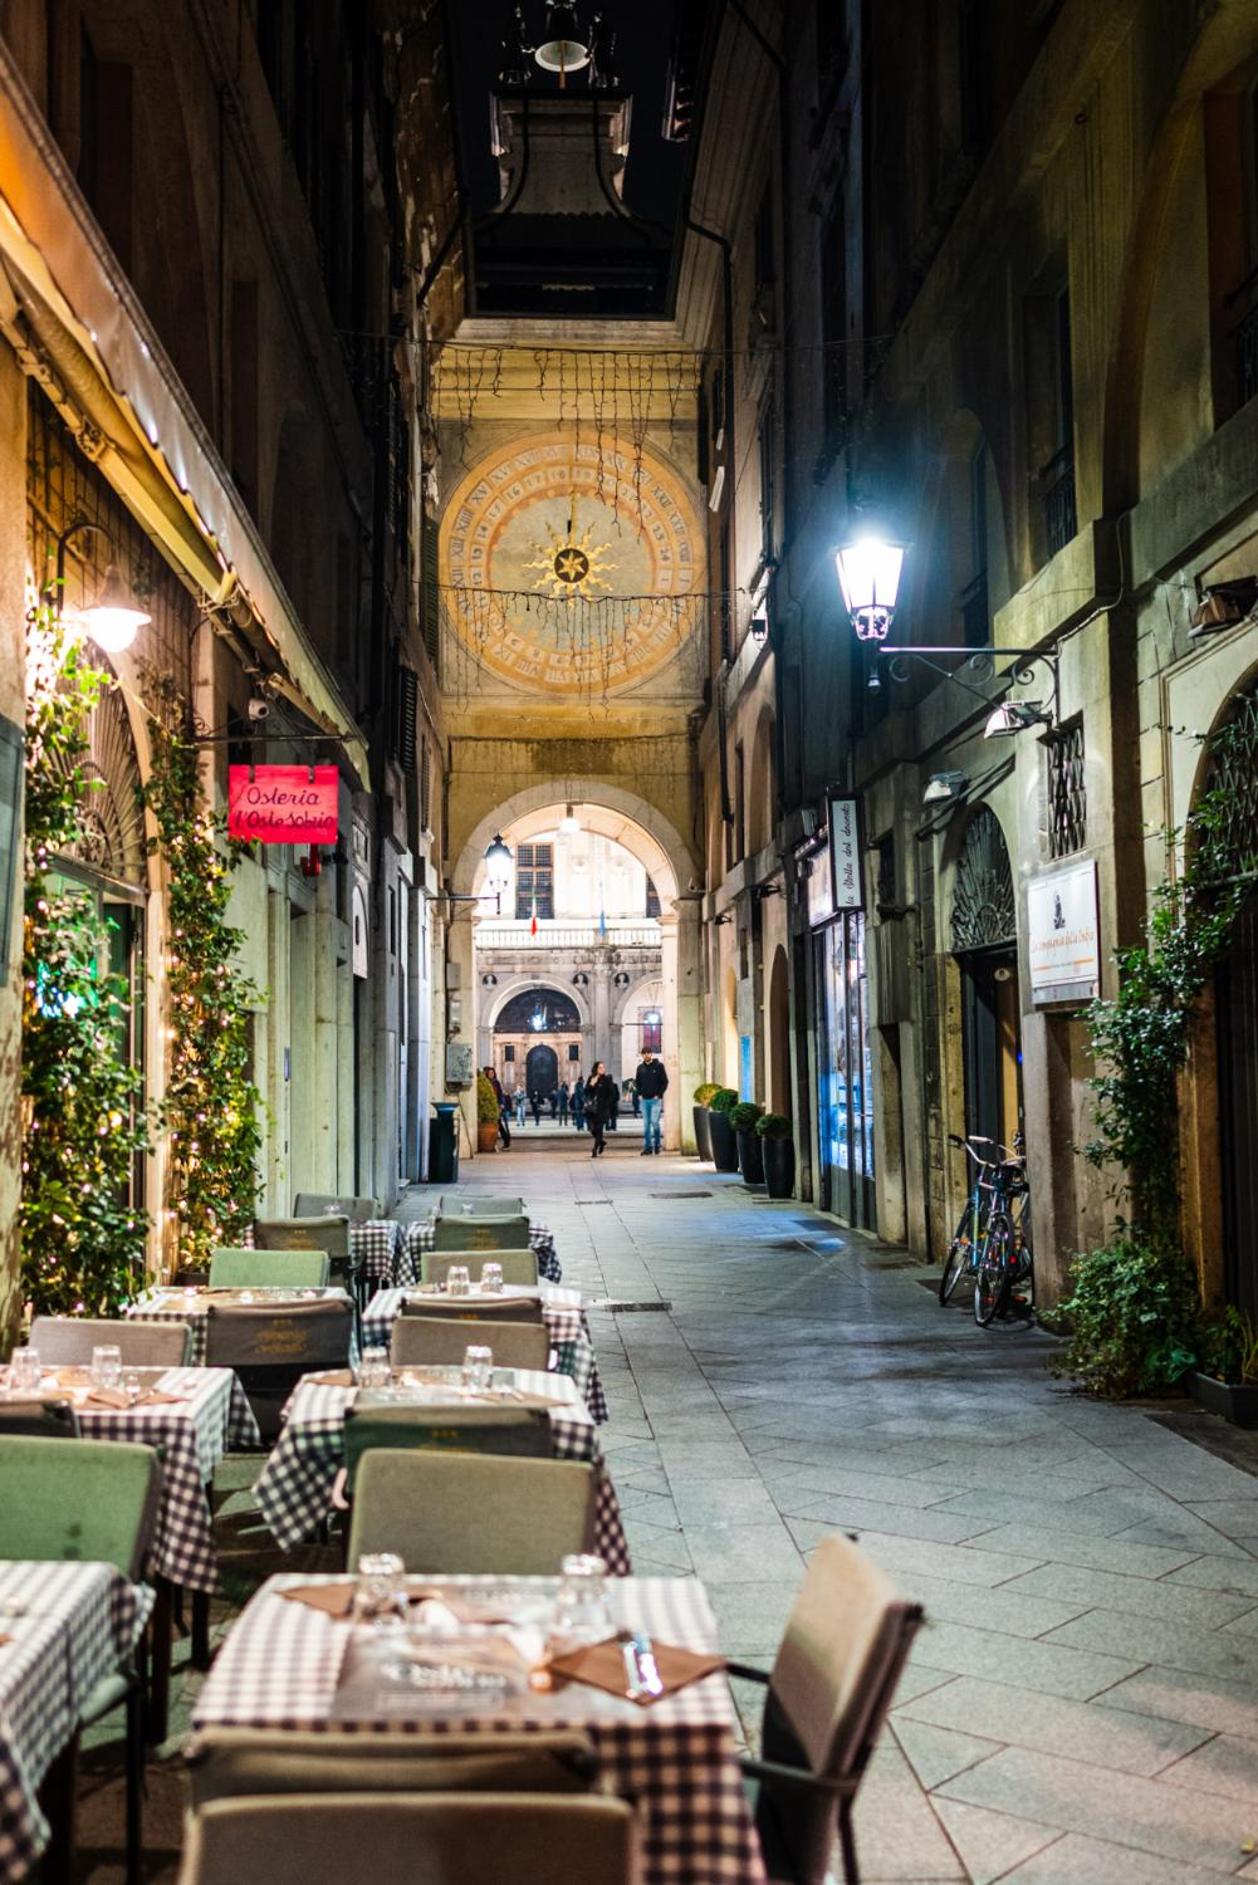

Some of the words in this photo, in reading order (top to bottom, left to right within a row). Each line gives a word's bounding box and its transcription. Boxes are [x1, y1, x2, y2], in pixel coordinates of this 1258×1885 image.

[247, 786, 319, 806] Osteria
[842, 842, 852, 858] del
[846, 895, 855, 906] la
